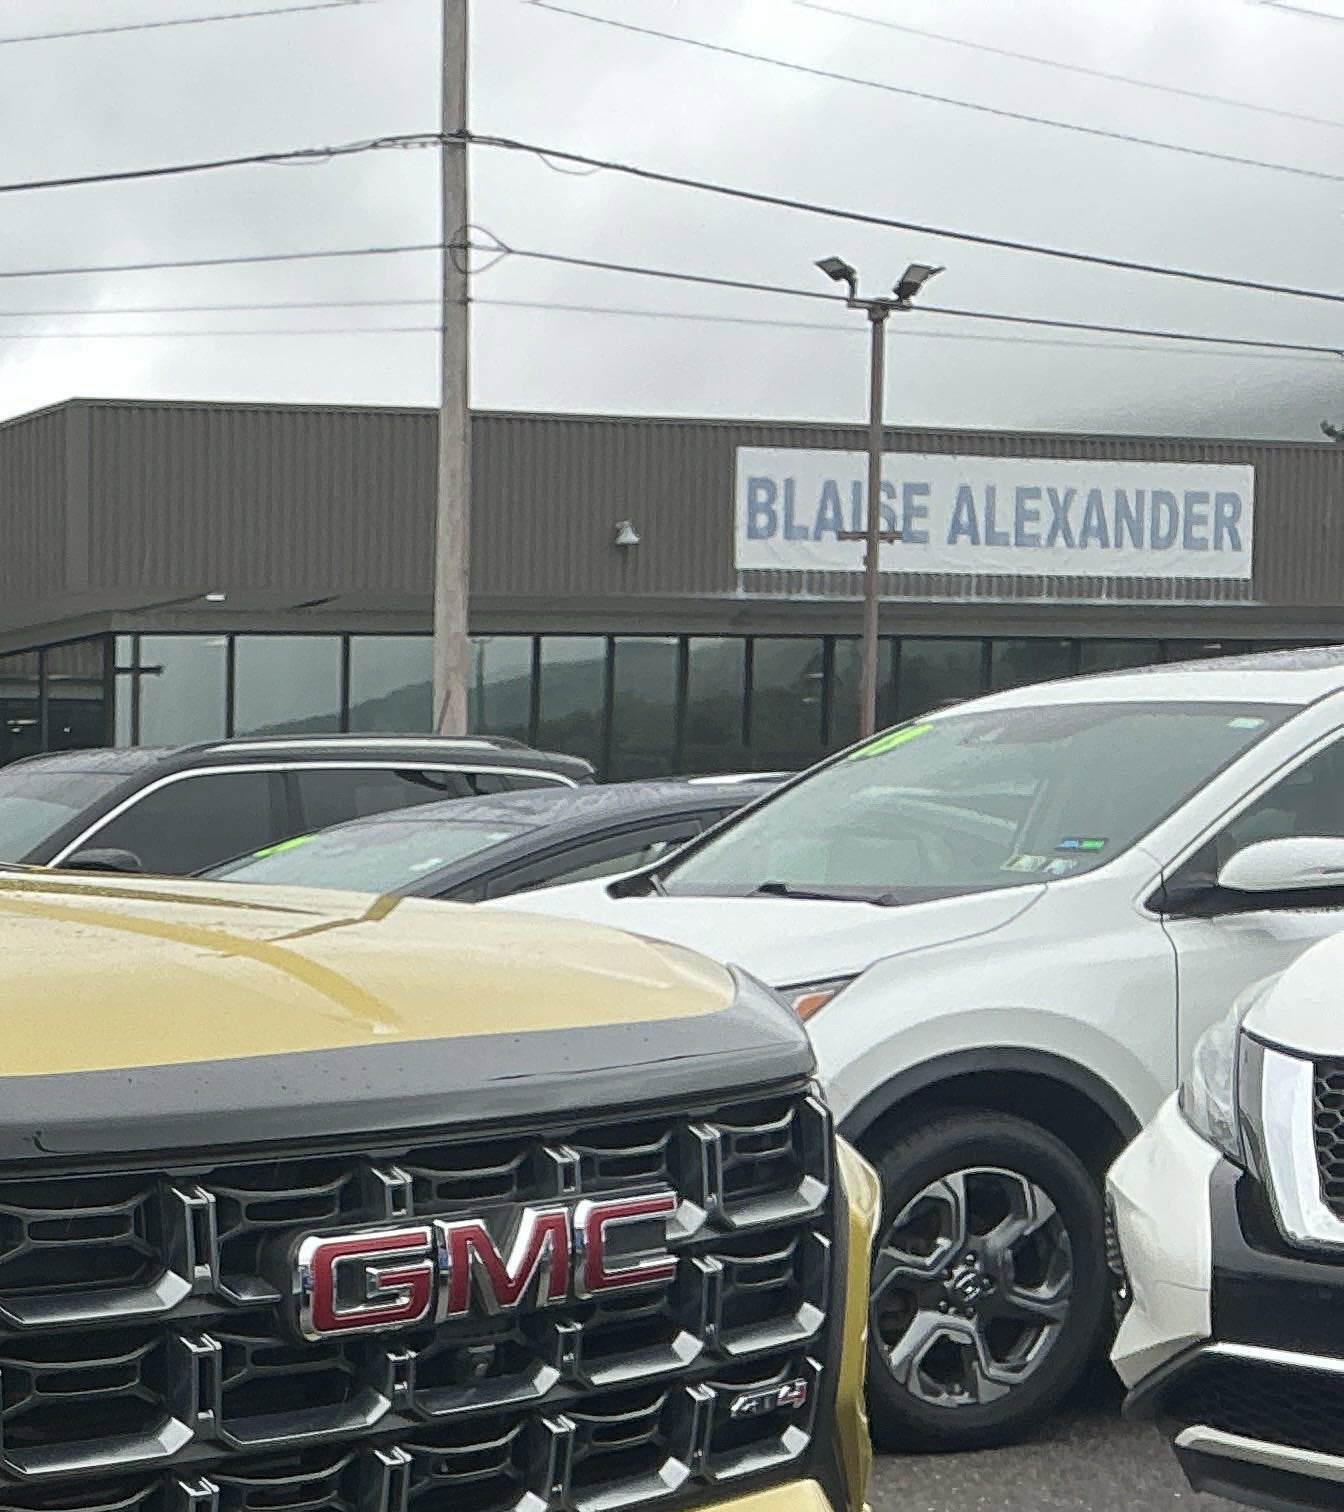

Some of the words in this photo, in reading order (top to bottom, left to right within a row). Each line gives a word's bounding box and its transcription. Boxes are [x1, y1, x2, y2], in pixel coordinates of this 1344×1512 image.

[746, 476, 930, 544] BLAISE
[946, 484, 1243, 551] ALEXANDER
[296, 1186, 680, 1341] GMC
